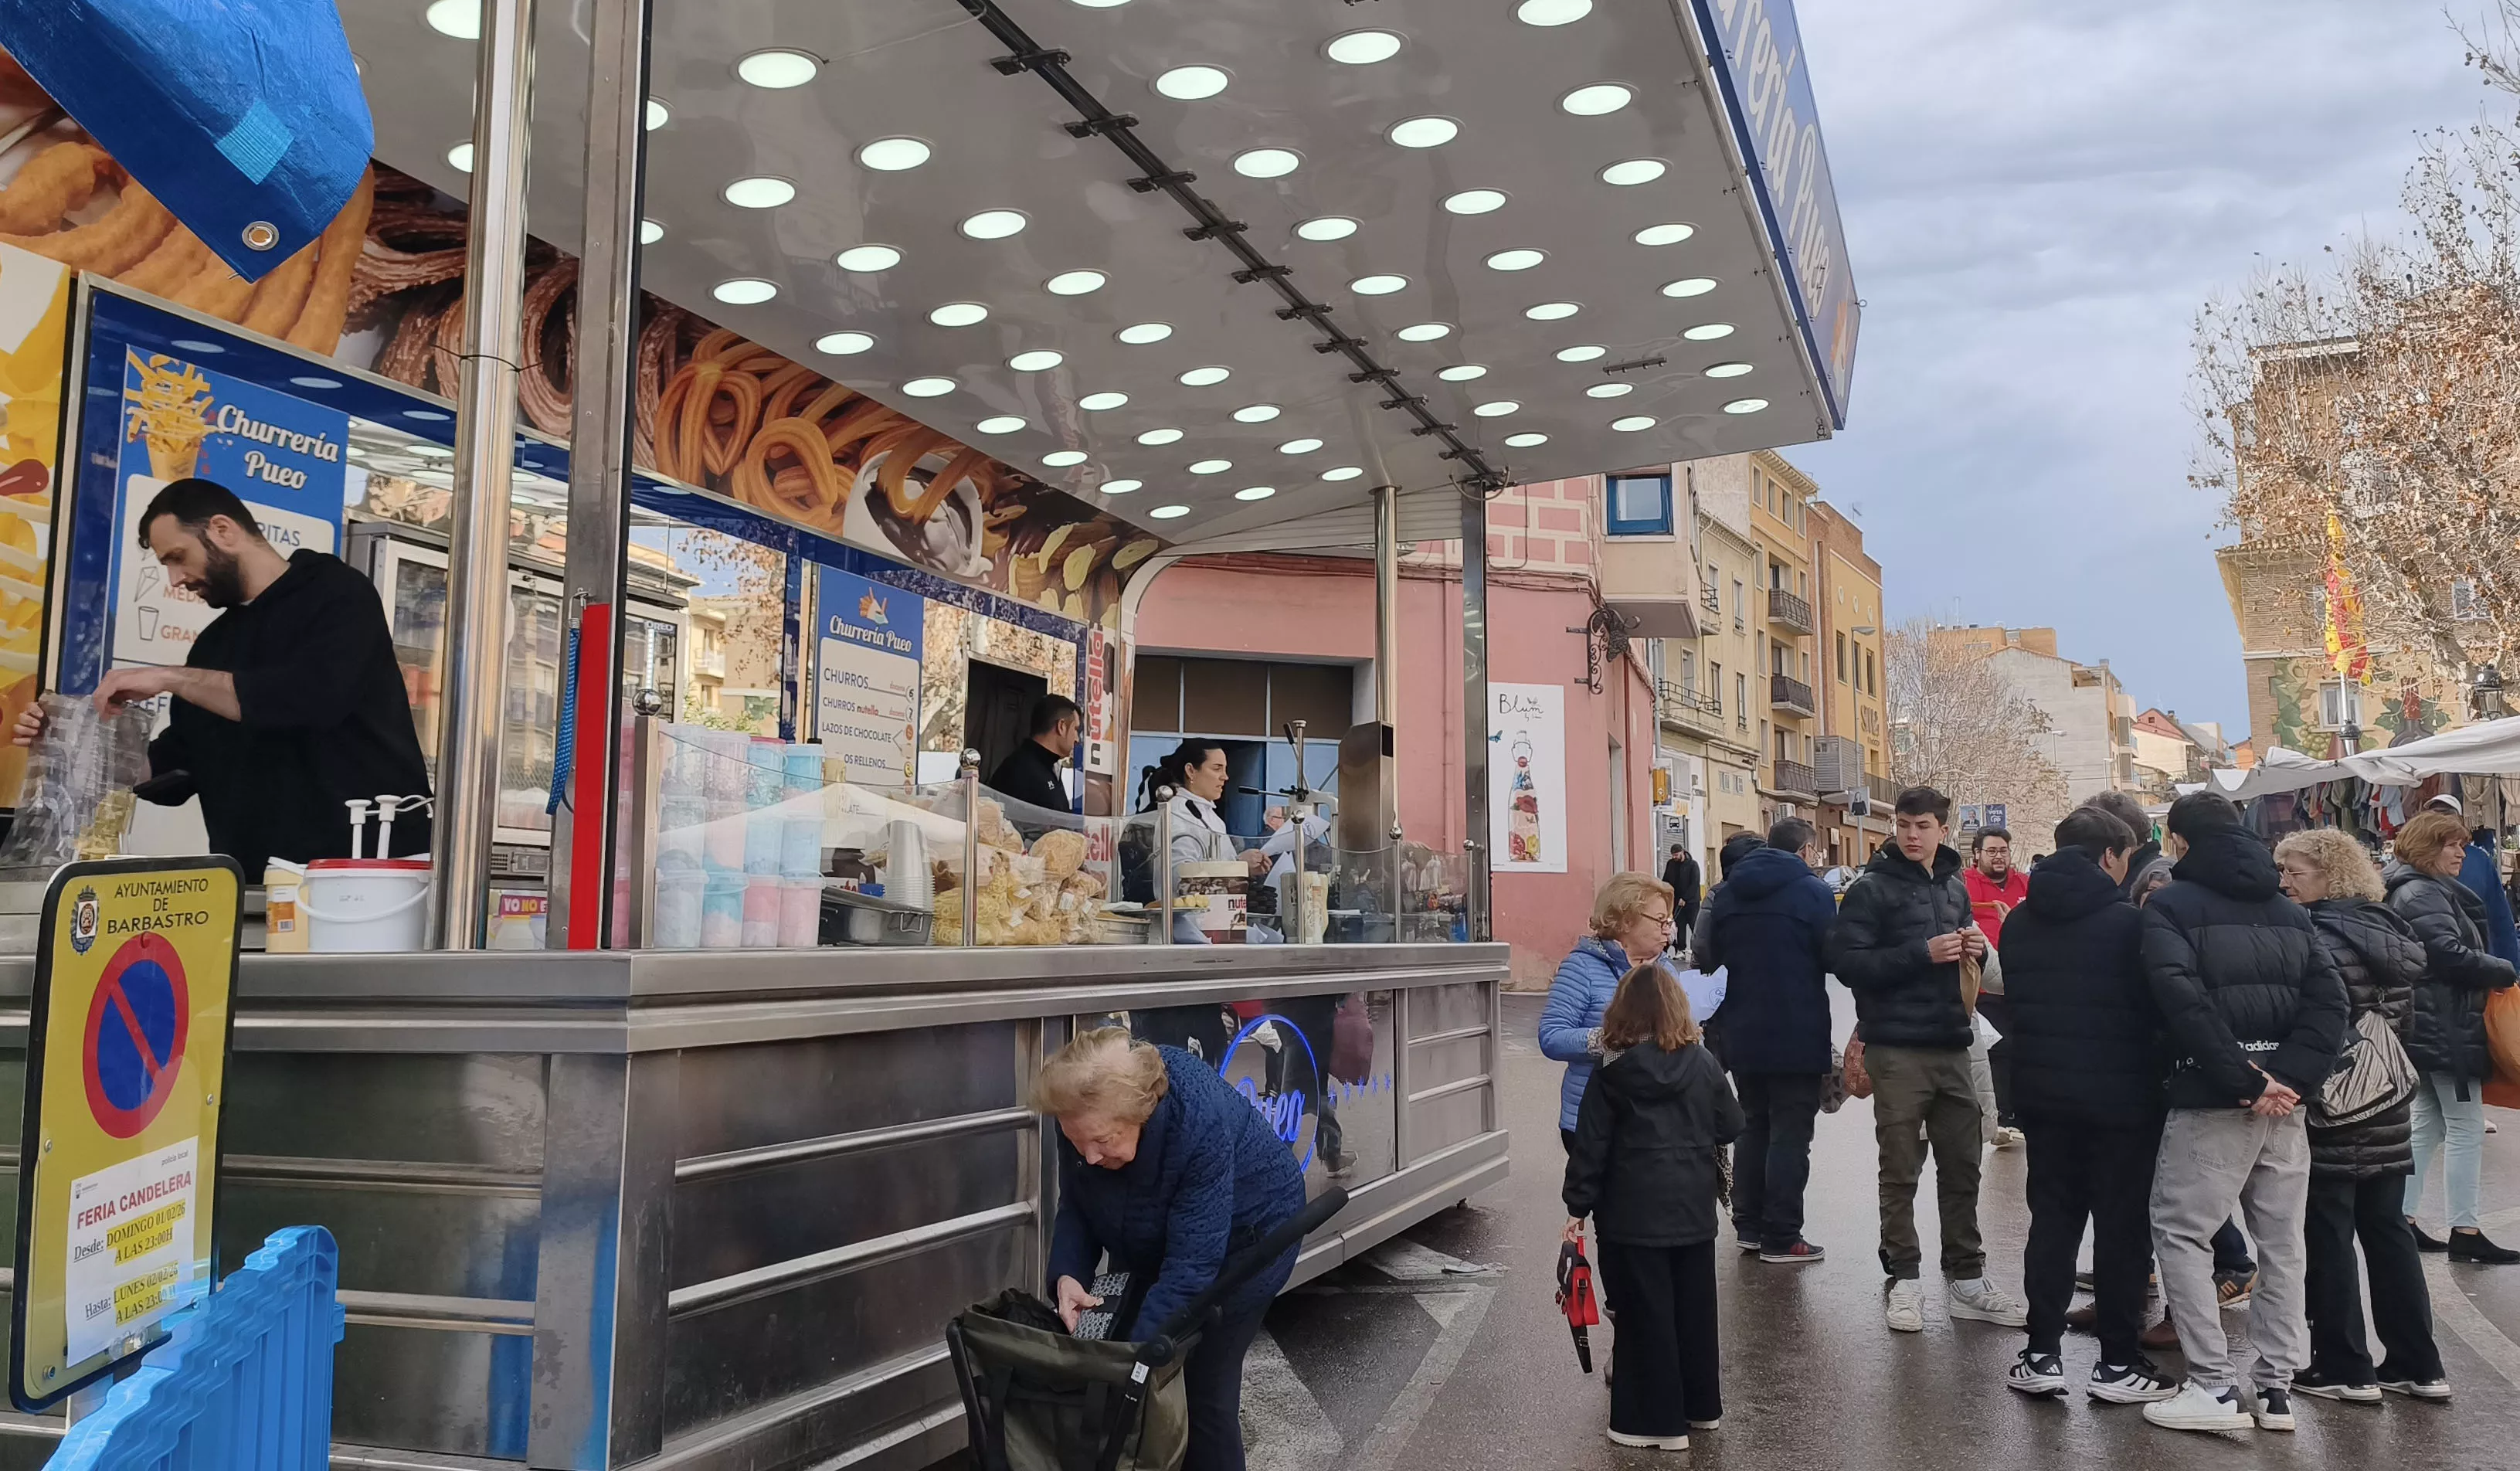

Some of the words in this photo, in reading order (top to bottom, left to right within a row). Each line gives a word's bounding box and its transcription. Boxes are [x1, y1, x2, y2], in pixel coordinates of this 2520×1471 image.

[217, 403, 339, 463] Churrería
[244, 450, 308, 490] Pueo
[646, 620, 674, 632] OREO
[830, 614, 885, 647] Churrería
[885, 629, 912, 652] Pueo
[824, 667, 869, 689] CHURROS
[822, 697, 856, 712] CHURROS
[857, 705, 879, 716] nutella
[1088, 628, 1104, 766] nutella
[1499, 693, 1544, 714] Blum
[822, 721, 843, 735] LAZOS
[844, 726, 852, 736] DE
[854, 727, 892, 743] CHOCOLATE
[854, 756, 886, 769] RELLENOS
[114, 878, 209, 899] AYUNTAMIENTO
[153, 897, 169, 912] DE
[504, 898, 520, 912] YO
[521, 899, 538, 912] NO
[107, 910, 209, 935] BARBASTRO
[76, 1200, 116, 1230] FERIA
[120, 1170, 192, 1213] CANDELERA
[74, 1239, 104, 1260] Desde:
[107, 1215, 155, 1248] DOMINGO
[155, 1201, 186, 1227] 01/02/26
[115, 1248, 122, 1264] A
[124, 1241, 143, 1259] LAS
[85, 1296, 111, 1318] Hasta:
[114, 1282, 145, 1304] LUNES
[147, 1264, 178, 1288] 02/02/26
[116, 1309, 123, 1324] A
[124, 1299, 144, 1321] LAS
